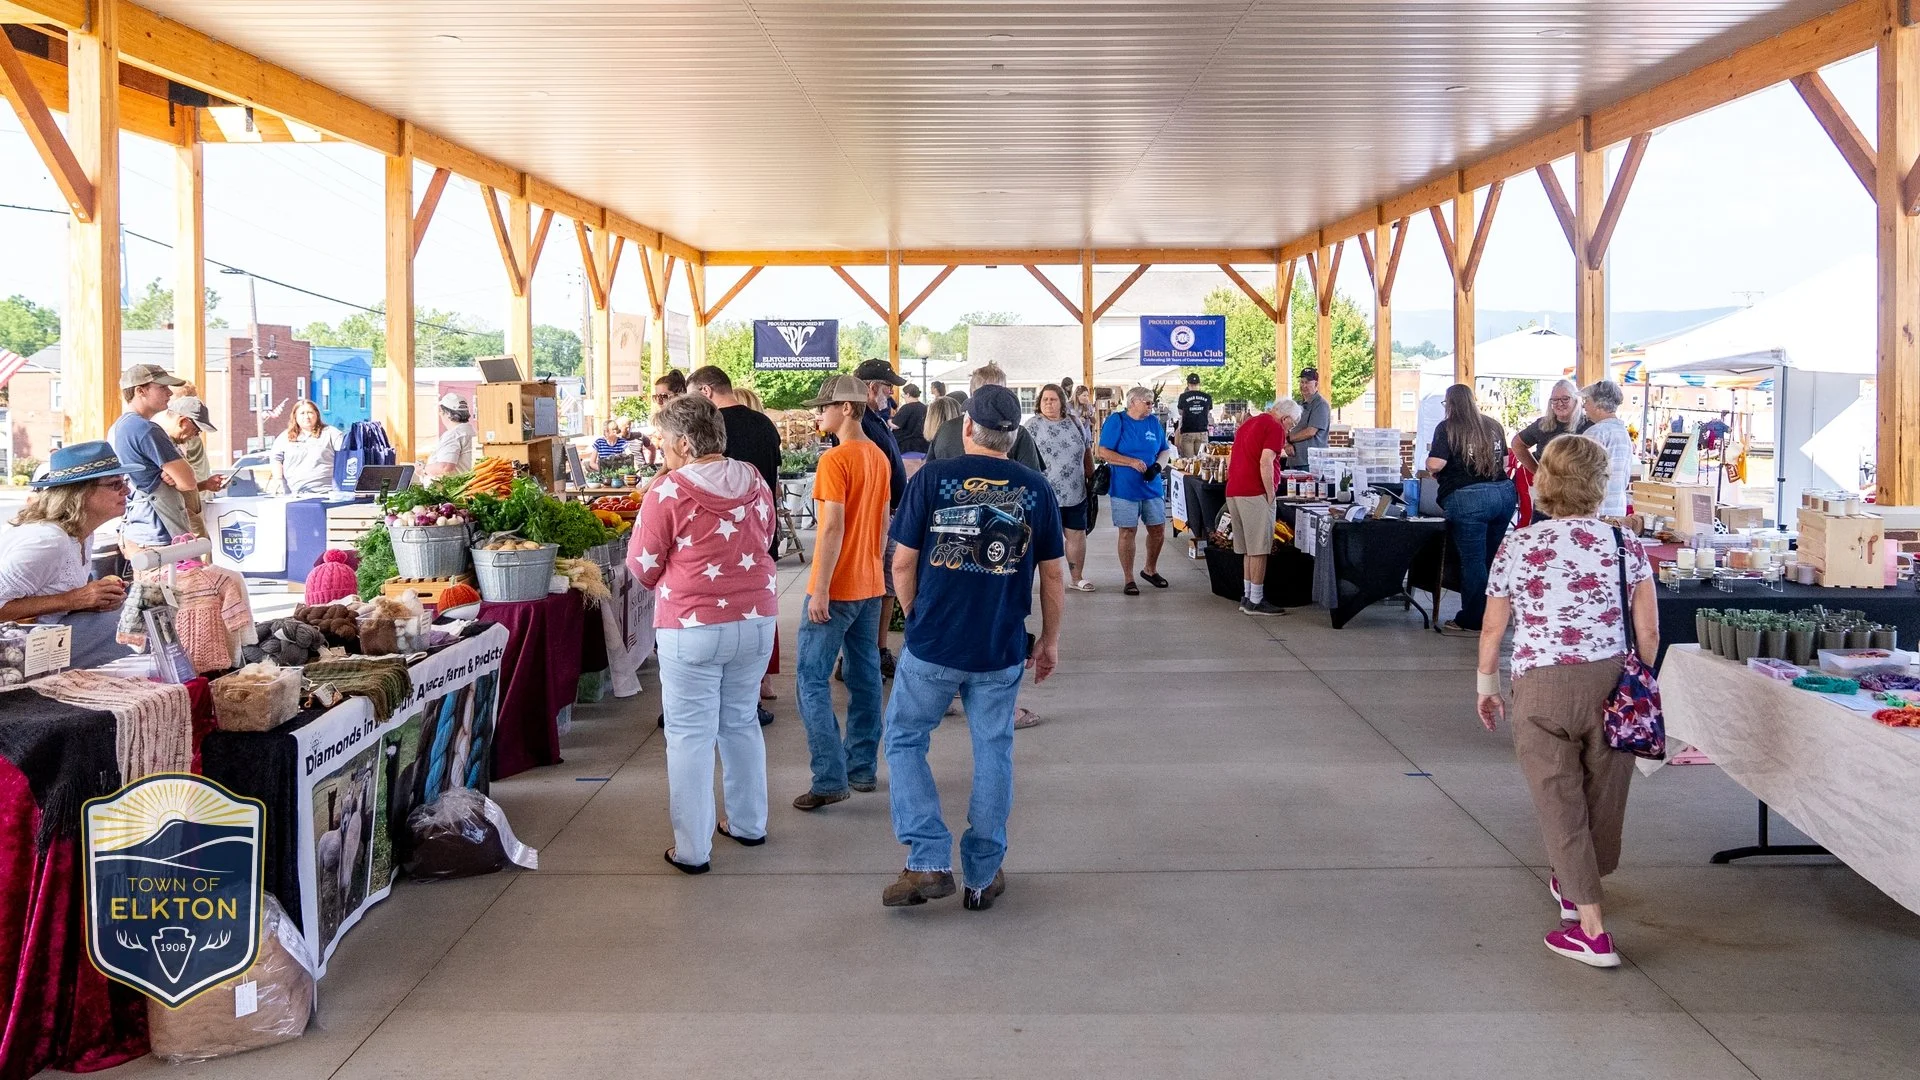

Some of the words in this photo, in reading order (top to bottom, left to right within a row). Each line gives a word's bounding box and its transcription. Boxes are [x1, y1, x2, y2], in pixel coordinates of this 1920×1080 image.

[776, 326, 817, 356] EPIC
[1143, 349, 1171, 357] Elkton
[1171, 349, 1203, 357] Ruritan
[1203, 349, 1223, 357] Club
[953, 477, 1026, 504] Ford
[929, 543, 969, 570] 66
[305, 726, 361, 776] Diamonds
[363, 718, 374, 736] in
[416, 674, 444, 700] Aaca
[444, 664, 466, 685] Farm
[467, 658, 474, 673] &
